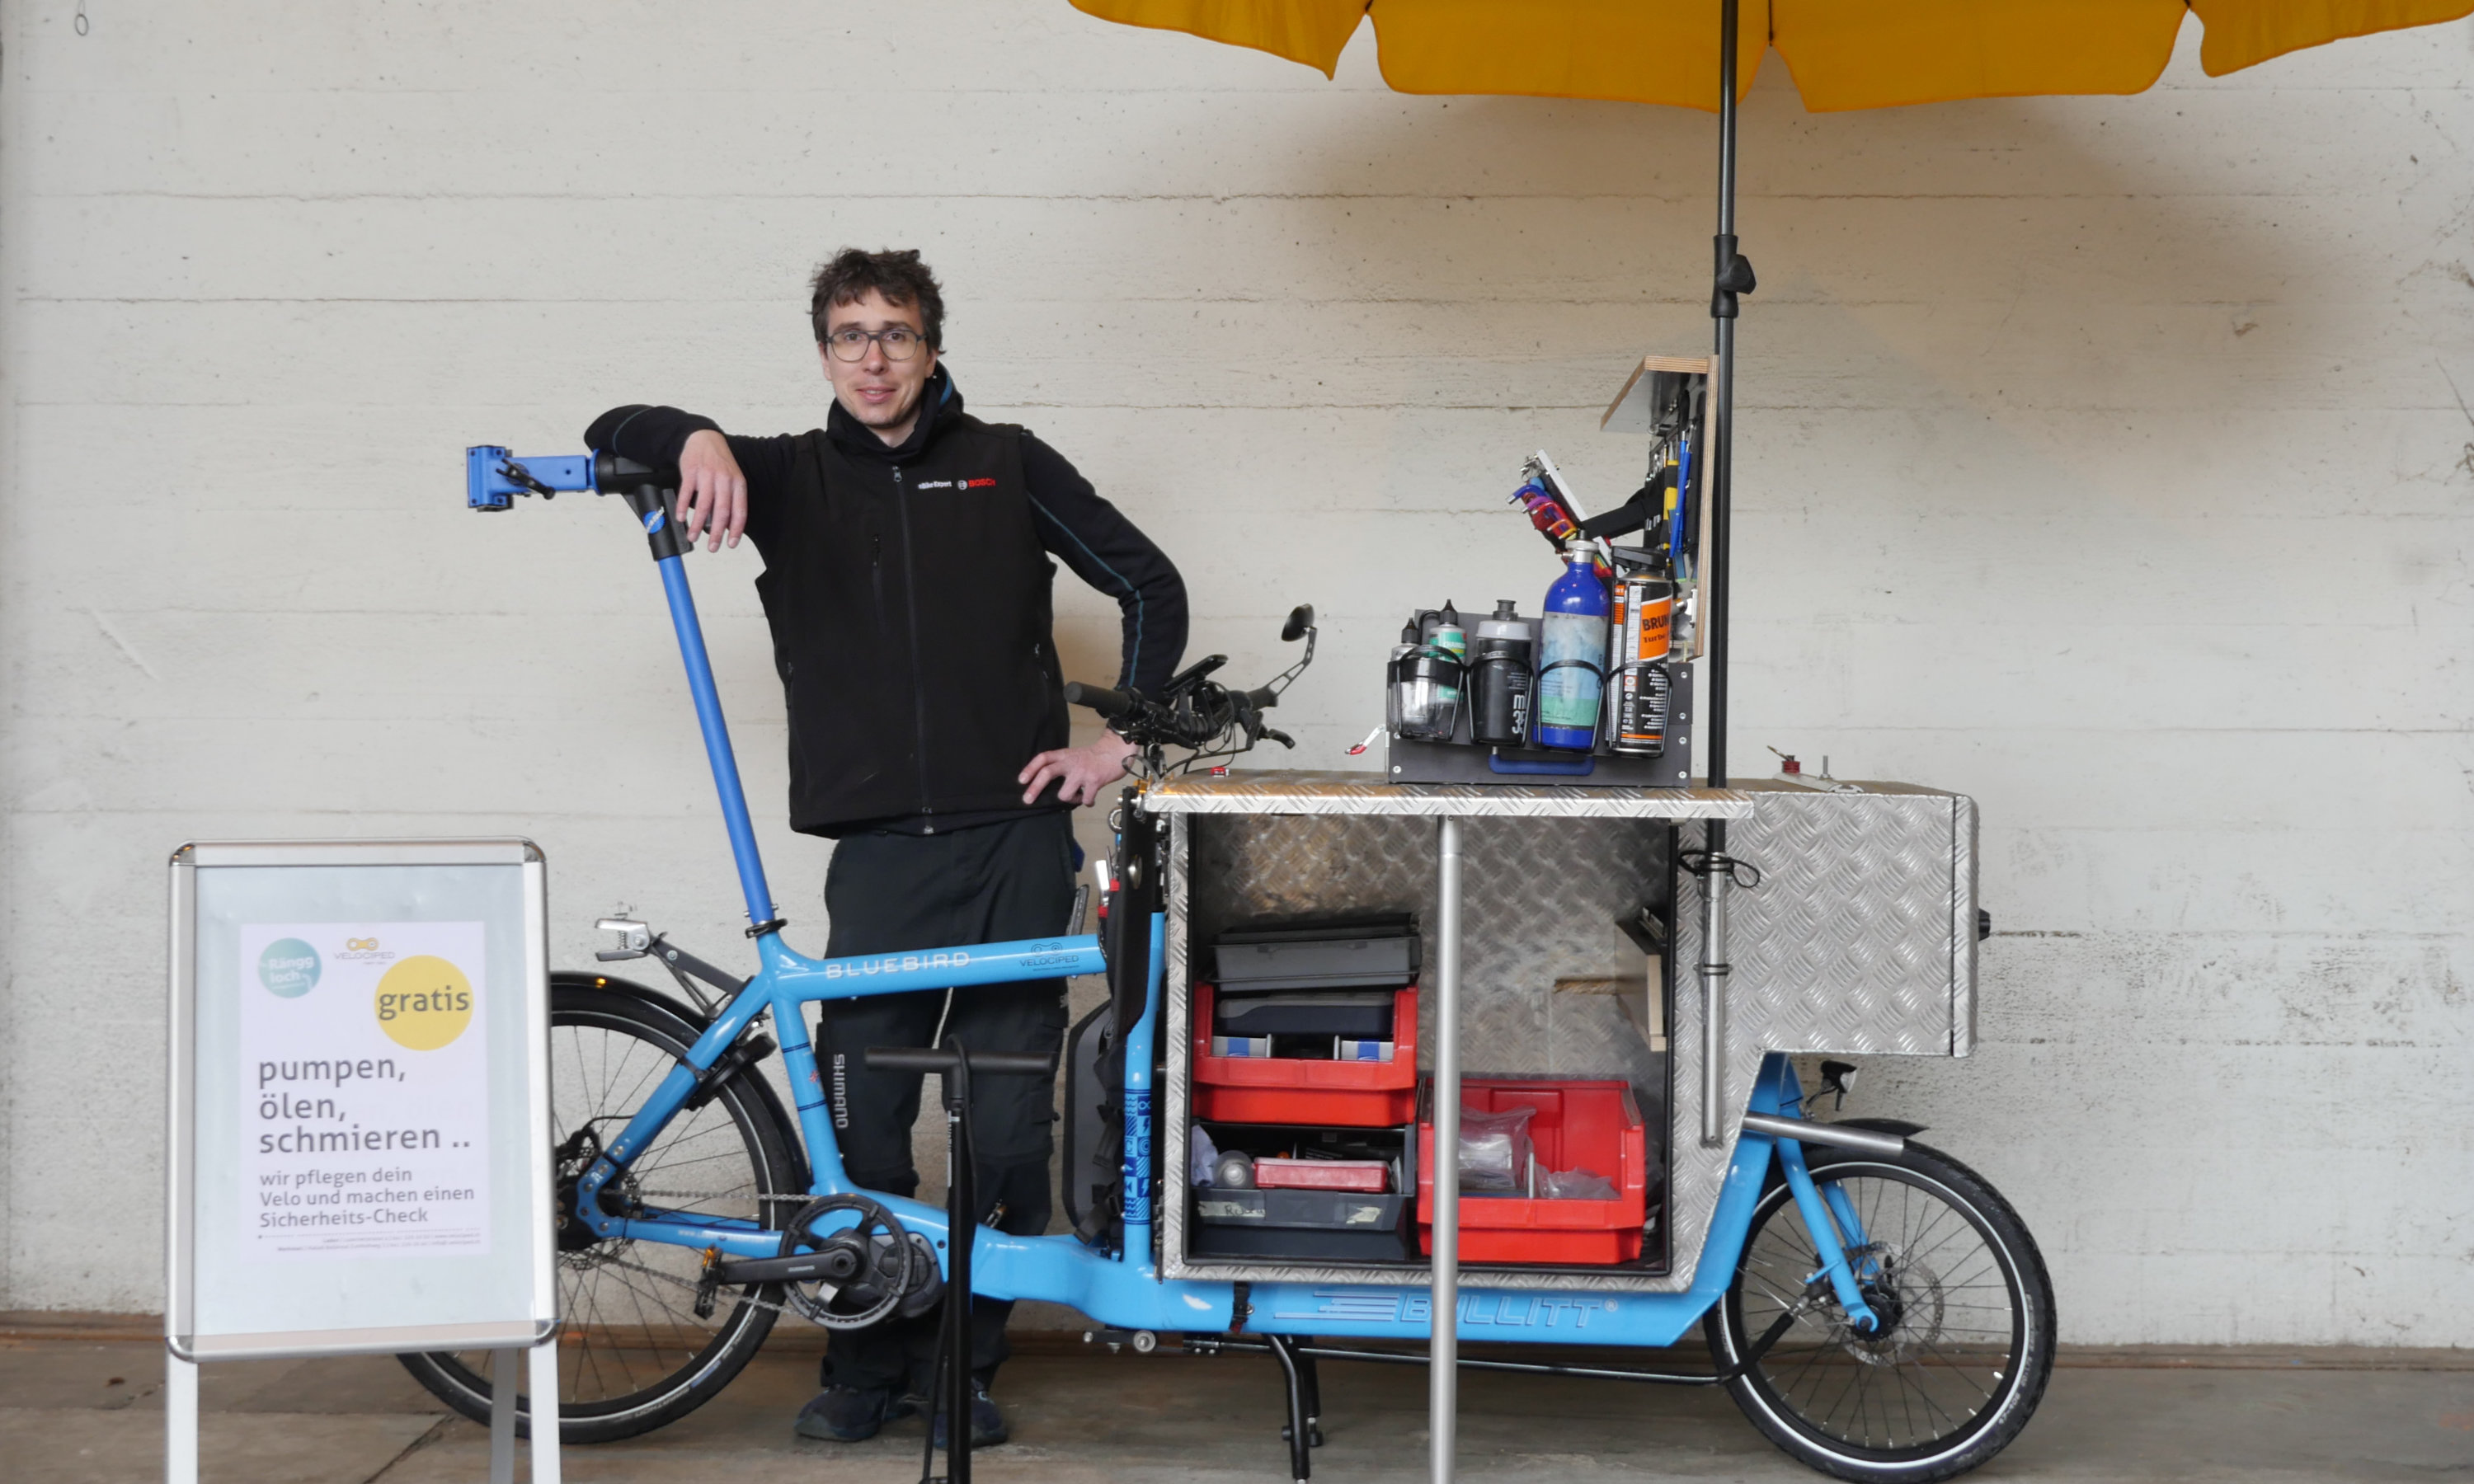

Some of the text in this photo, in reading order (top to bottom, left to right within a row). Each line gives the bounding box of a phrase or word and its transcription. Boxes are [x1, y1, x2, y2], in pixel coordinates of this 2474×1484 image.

[270, 956, 314, 970] Rängg
[334, 951, 395, 960] VELOCIPED
[826, 951, 971, 979] BLUEBIRD
[1019, 955, 1079, 967] VELOCIPED
[270, 970, 301, 983] loch
[379, 985, 470, 1021] gratis
[259, 1058, 406, 1090] pumpen,
[833, 1054, 849, 1128] SHIMANO
[259, 1092, 346, 1122] ölen,
[259, 1124, 440, 1154] schmieren
[259, 1167, 412, 1190] wir pflegen dein
[259, 1186, 475, 1207] Velo und machen einen
[259, 1207, 429, 1228] Sicherheits-Check
